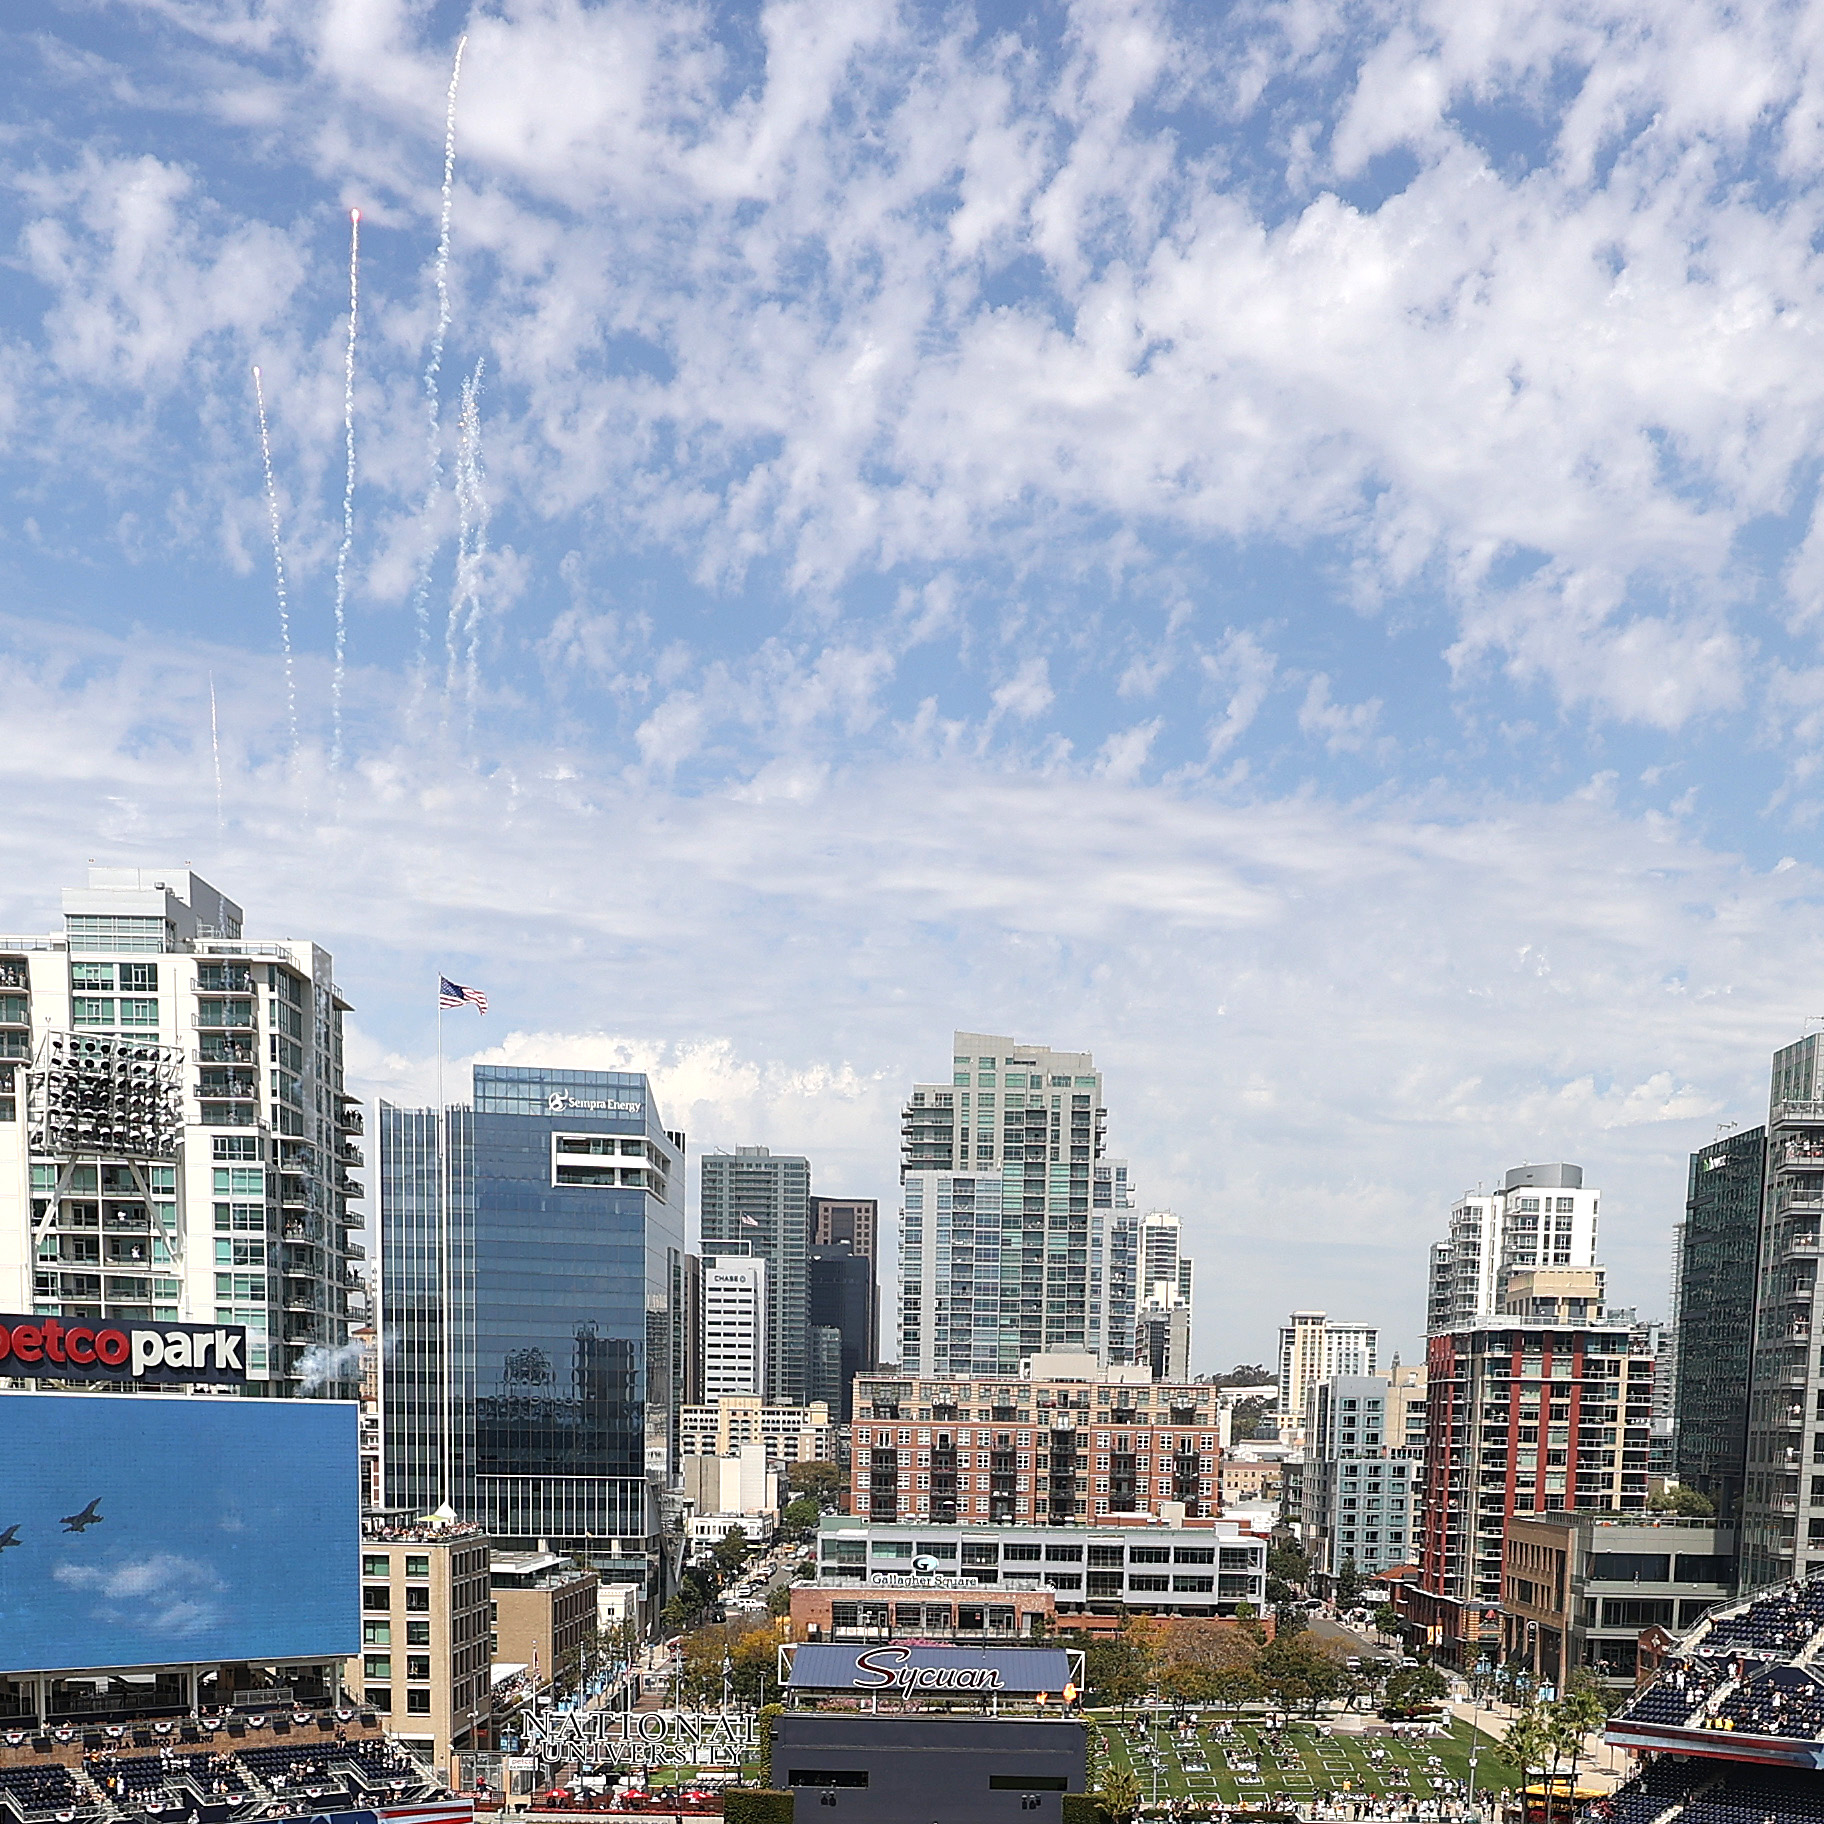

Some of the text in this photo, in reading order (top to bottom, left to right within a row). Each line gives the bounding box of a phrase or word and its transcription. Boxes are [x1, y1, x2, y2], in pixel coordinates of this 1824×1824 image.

[568, 1097, 641, 1112] Sempra Energy
[872, 1573, 977, 1588] Gallagher Square
[853, 1646, 1005, 1700] Sycuan
[521, 1709, 760, 1744] NATIONAL
[173, 1734, 214, 1746] LANDING
[540, 1741, 747, 1767] UNIVERSITY
